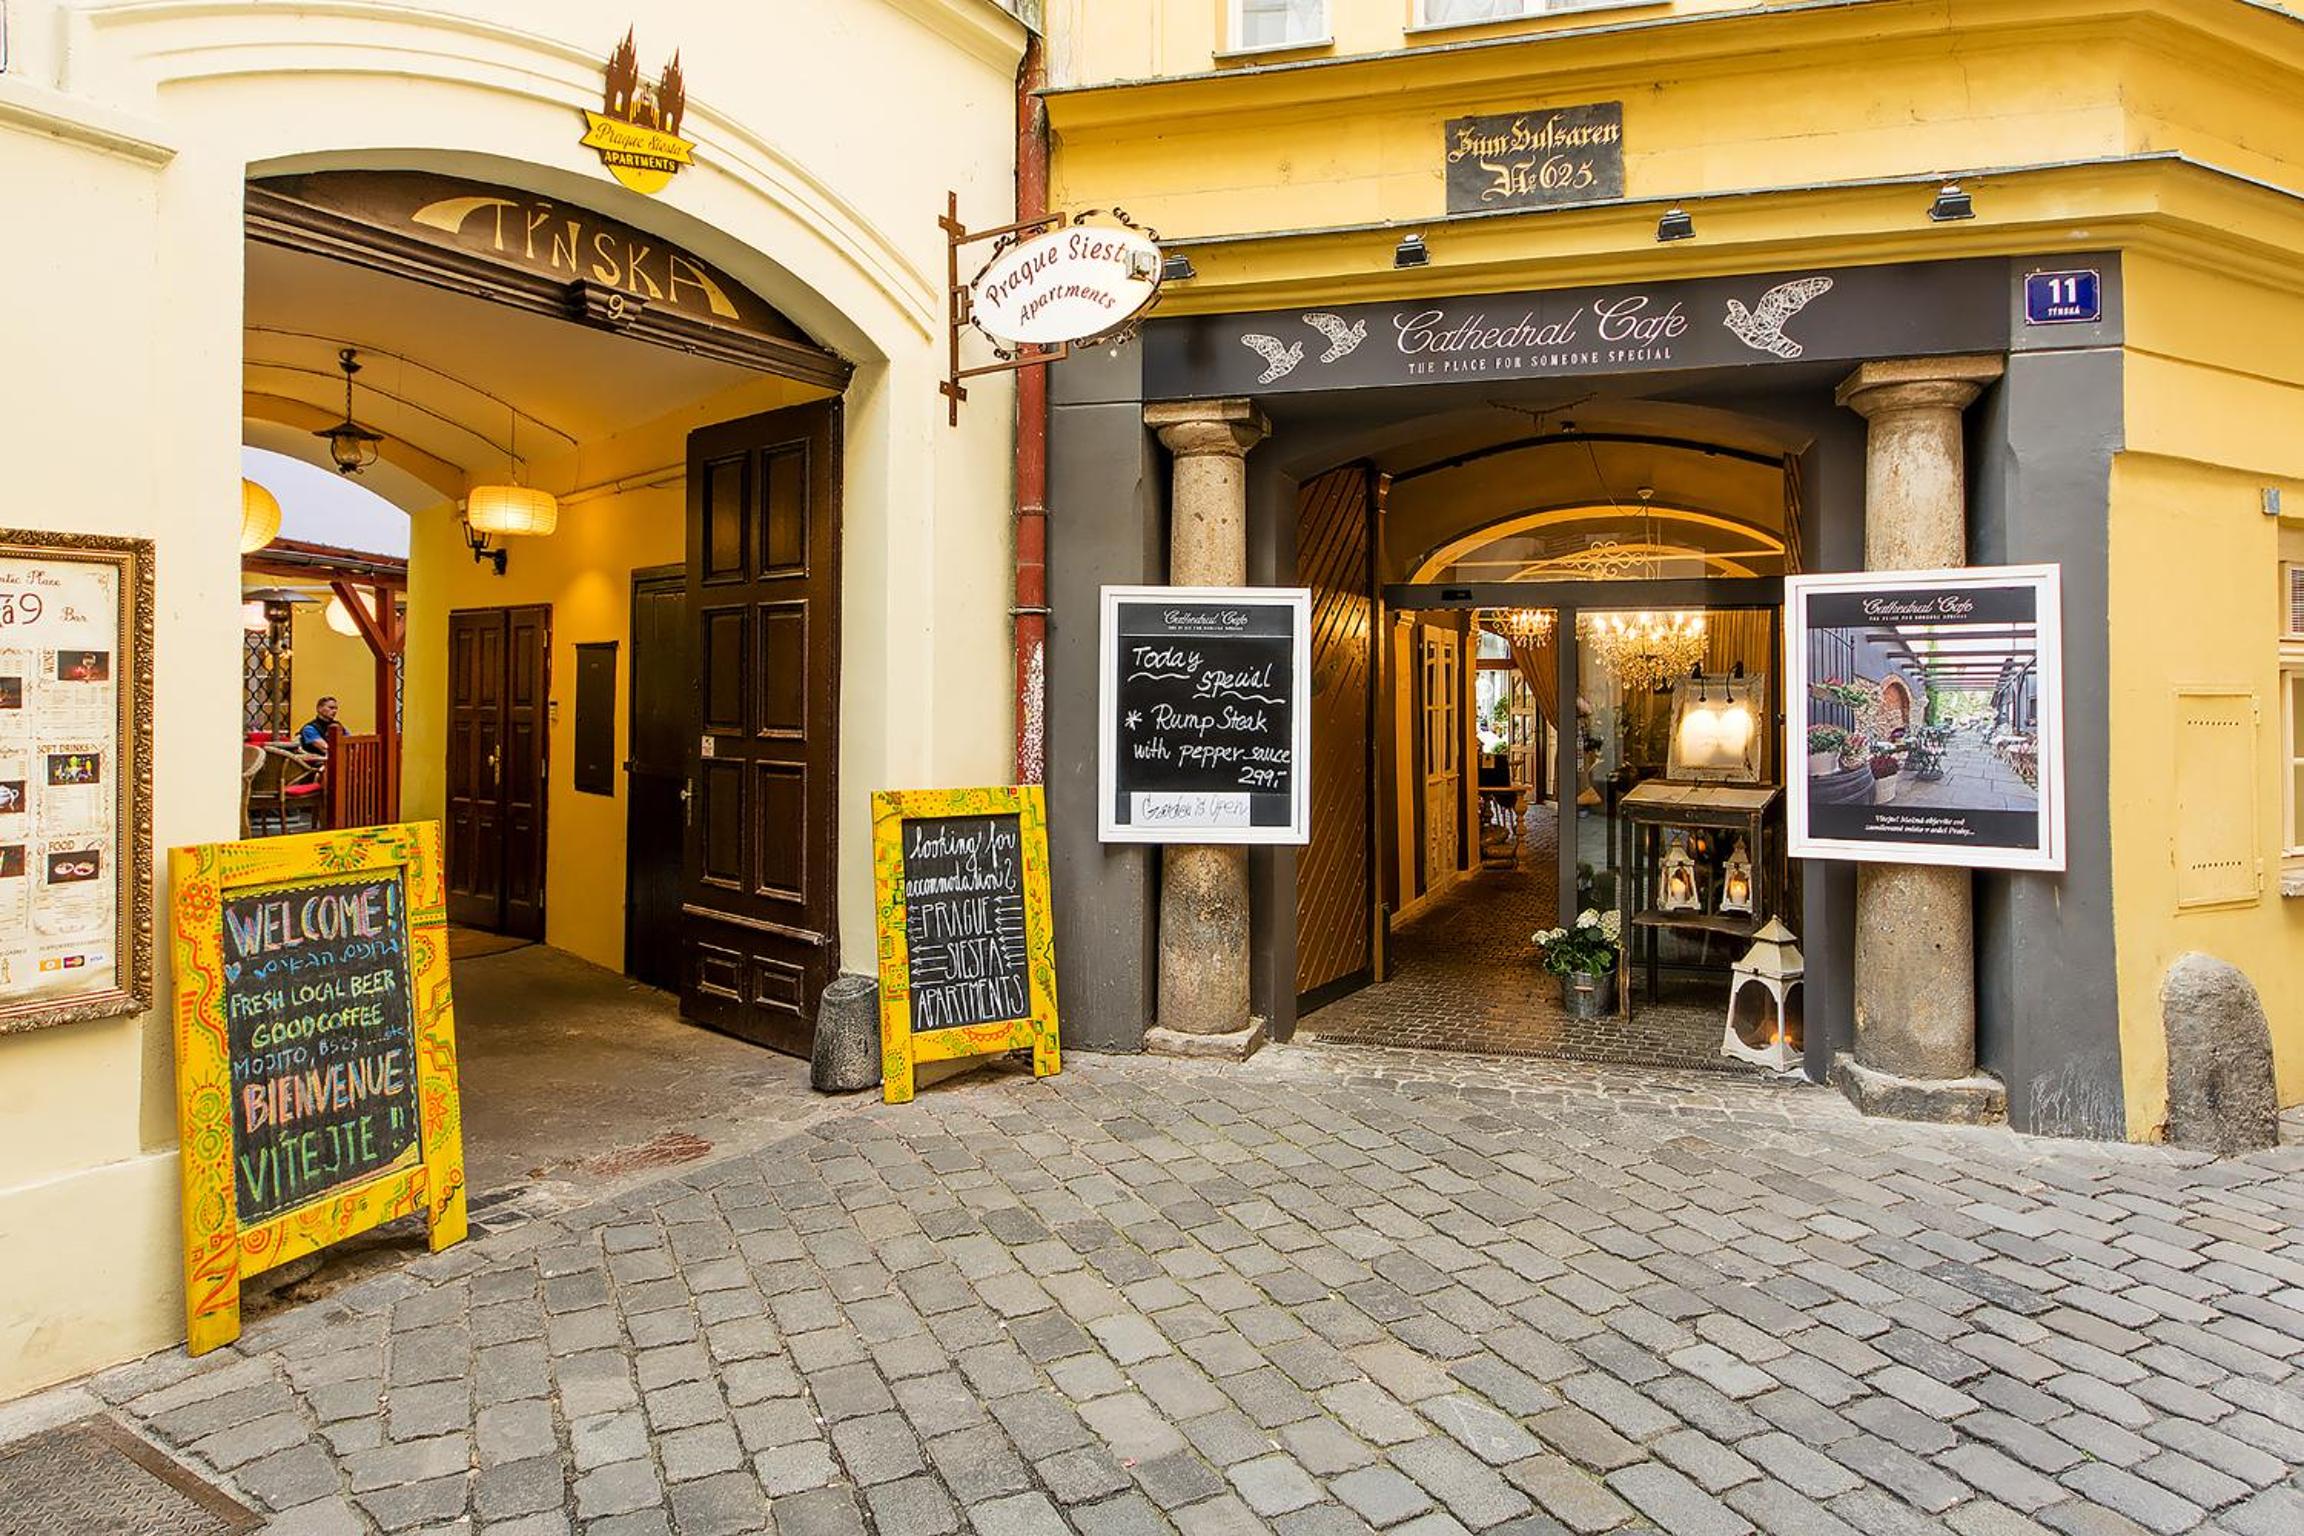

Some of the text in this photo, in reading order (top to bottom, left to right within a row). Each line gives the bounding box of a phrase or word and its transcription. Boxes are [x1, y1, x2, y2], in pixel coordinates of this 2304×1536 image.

[595, 122, 682, 156] Prague Siesta
[604, 151, 677, 171] APARTMENTS
[986, 233, 1129, 308] Prague Siest
[607, 294, 625, 319] 9
[1019, 281, 1116, 326] Apartments
[2048, 278, 2077, 303] 11
[1393, 296, 1689, 354] Cathedral Cafe
[1408, 347, 1672, 374] THE PLACE FOR SOMEONE SPECIAL
[1132, 646, 1204, 672] Today
[1151, 703, 1268, 737] Rump Steak
[37, 744, 56, 754] SOFT
[59, 744, 90, 753] DRINKS
[1134, 737, 1291, 768] with pepper sauce
[48, 840, 75, 852] FOOD
[911, 826, 981, 872] looking
[922, 897, 994, 938] PRAGUE
[945, 937, 1004, 980] SIESTA
[231, 969, 396, 1018] FRESH LOCAL BEER
[918, 974, 1024, 1029] APARTMENTS
[252, 1003, 384, 1048] GOOD COFFEE
[244, 1048, 405, 1134] BIENVENUE
